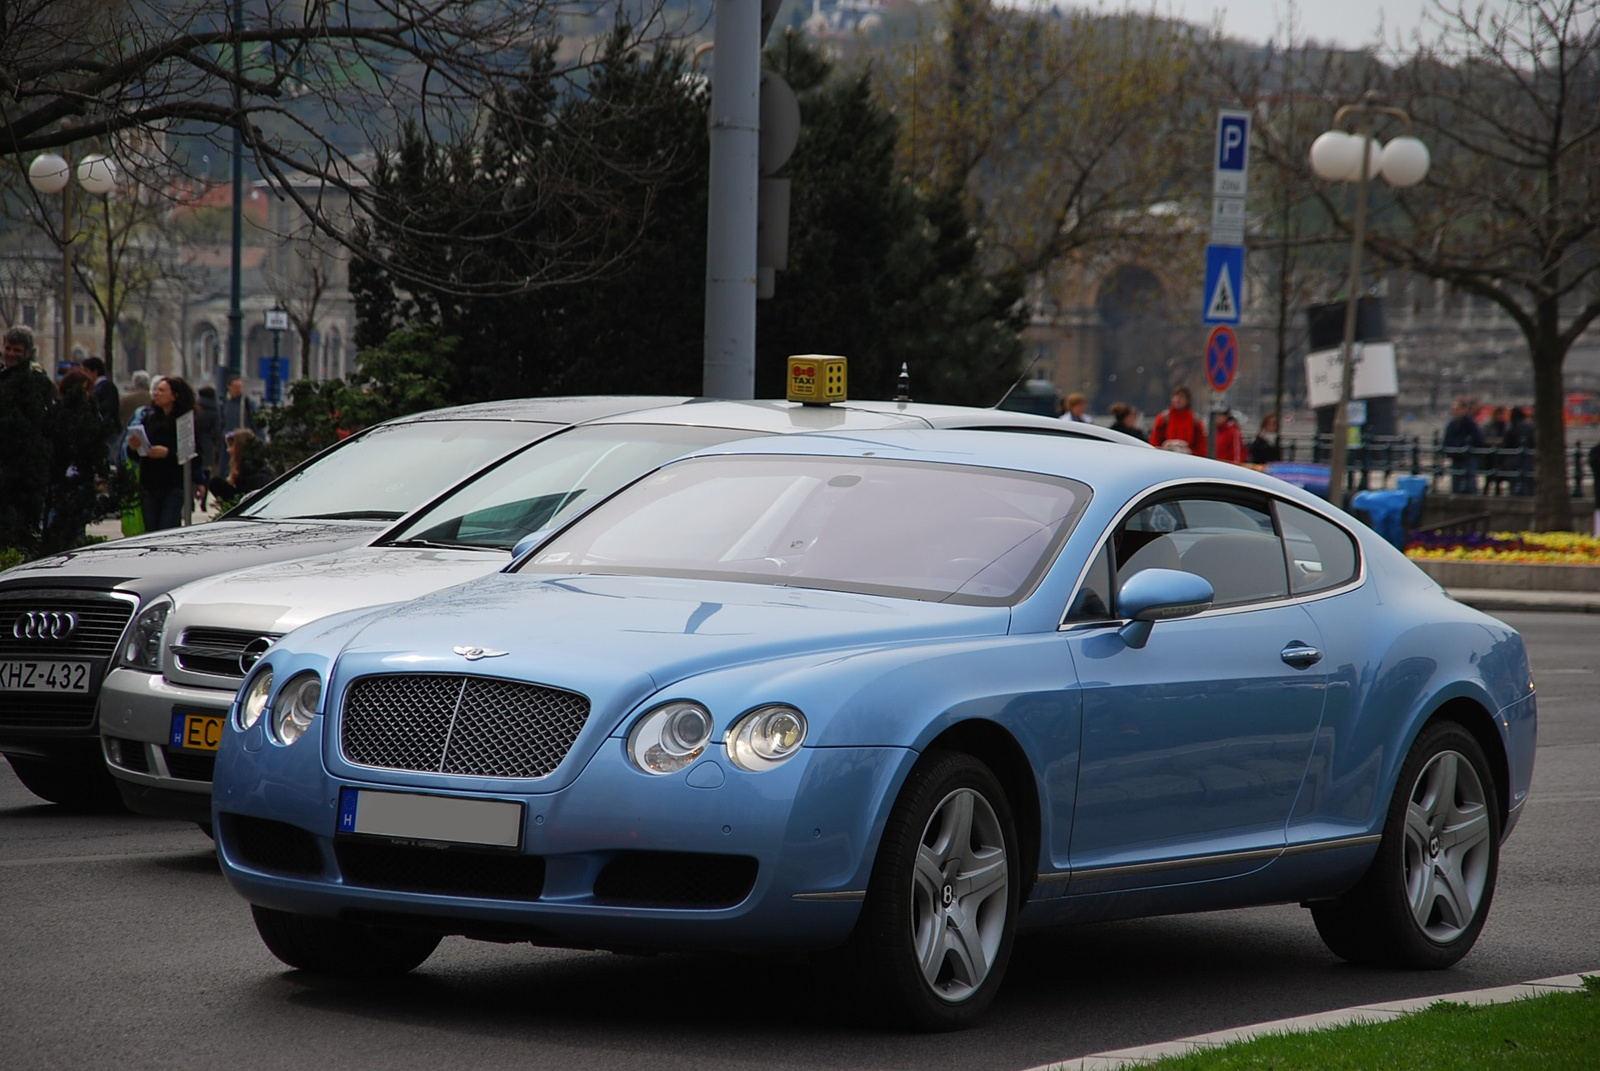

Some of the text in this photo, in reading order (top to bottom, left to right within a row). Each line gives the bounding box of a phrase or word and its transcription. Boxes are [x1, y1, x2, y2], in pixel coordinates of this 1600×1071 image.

[1223, 125, 1242, 162] P
[793, 377, 815, 385] TAXI
[0, 662, 86, 690] KHZ-432
[174, 732, 182, 743] H
[187, 717, 224, 747] EC
[343, 813, 352, 826] H
[943, 885, 952, 904] B
